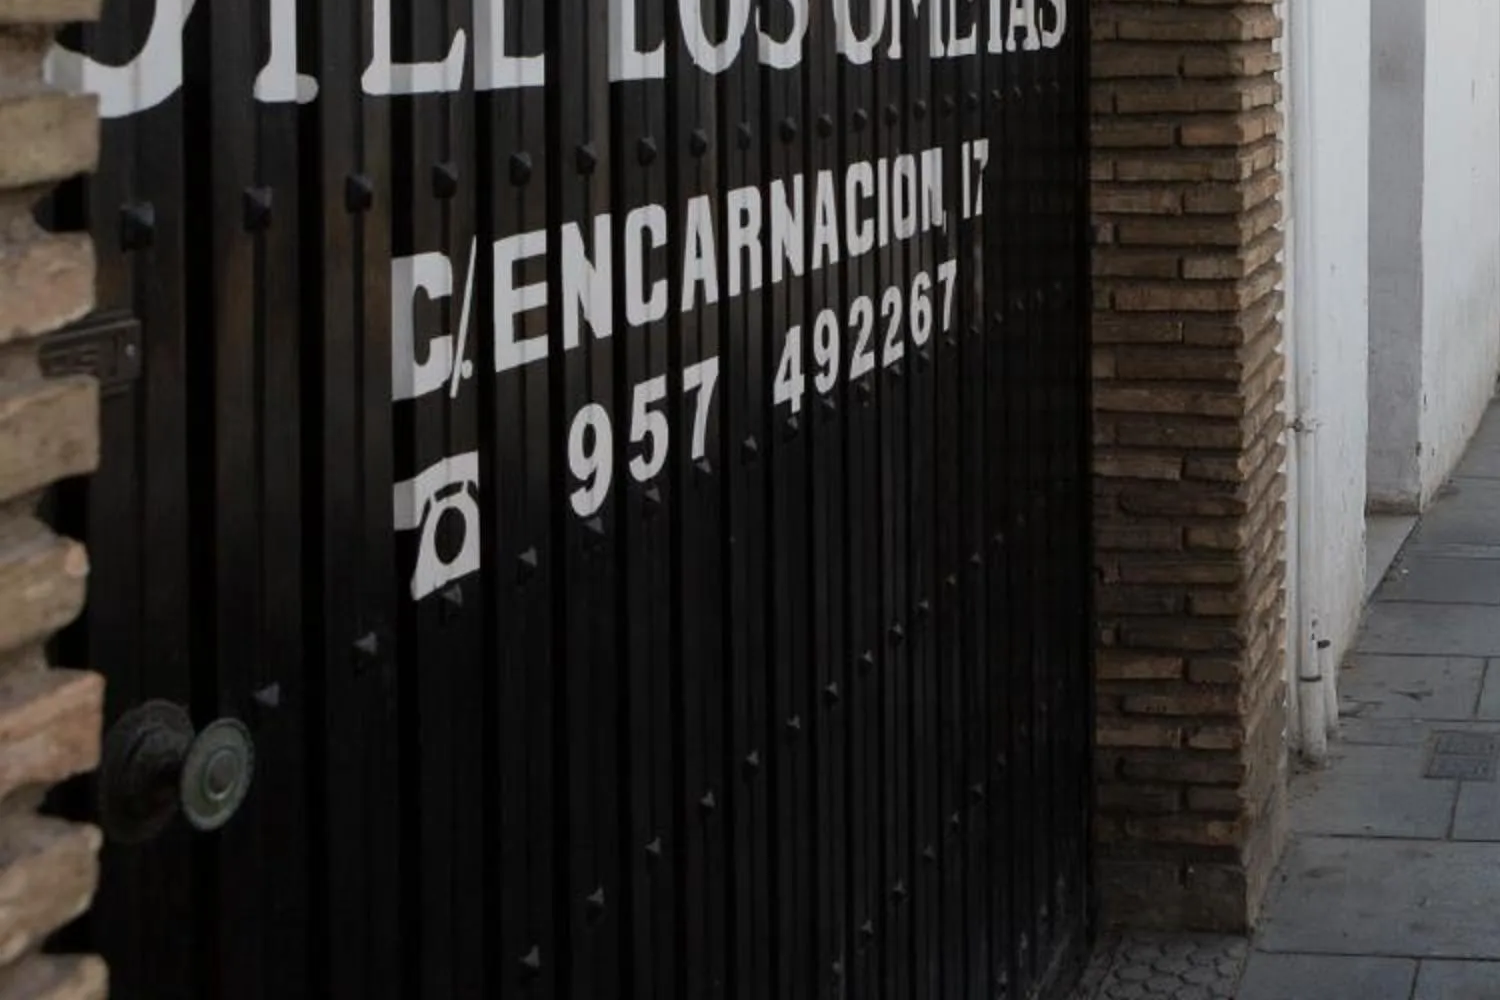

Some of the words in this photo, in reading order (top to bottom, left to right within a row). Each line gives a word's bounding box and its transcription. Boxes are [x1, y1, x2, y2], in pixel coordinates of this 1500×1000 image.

[962, 139, 989, 219] 17
[568, 356, 719, 517] 957
[773, 259, 957, 414] 492267
